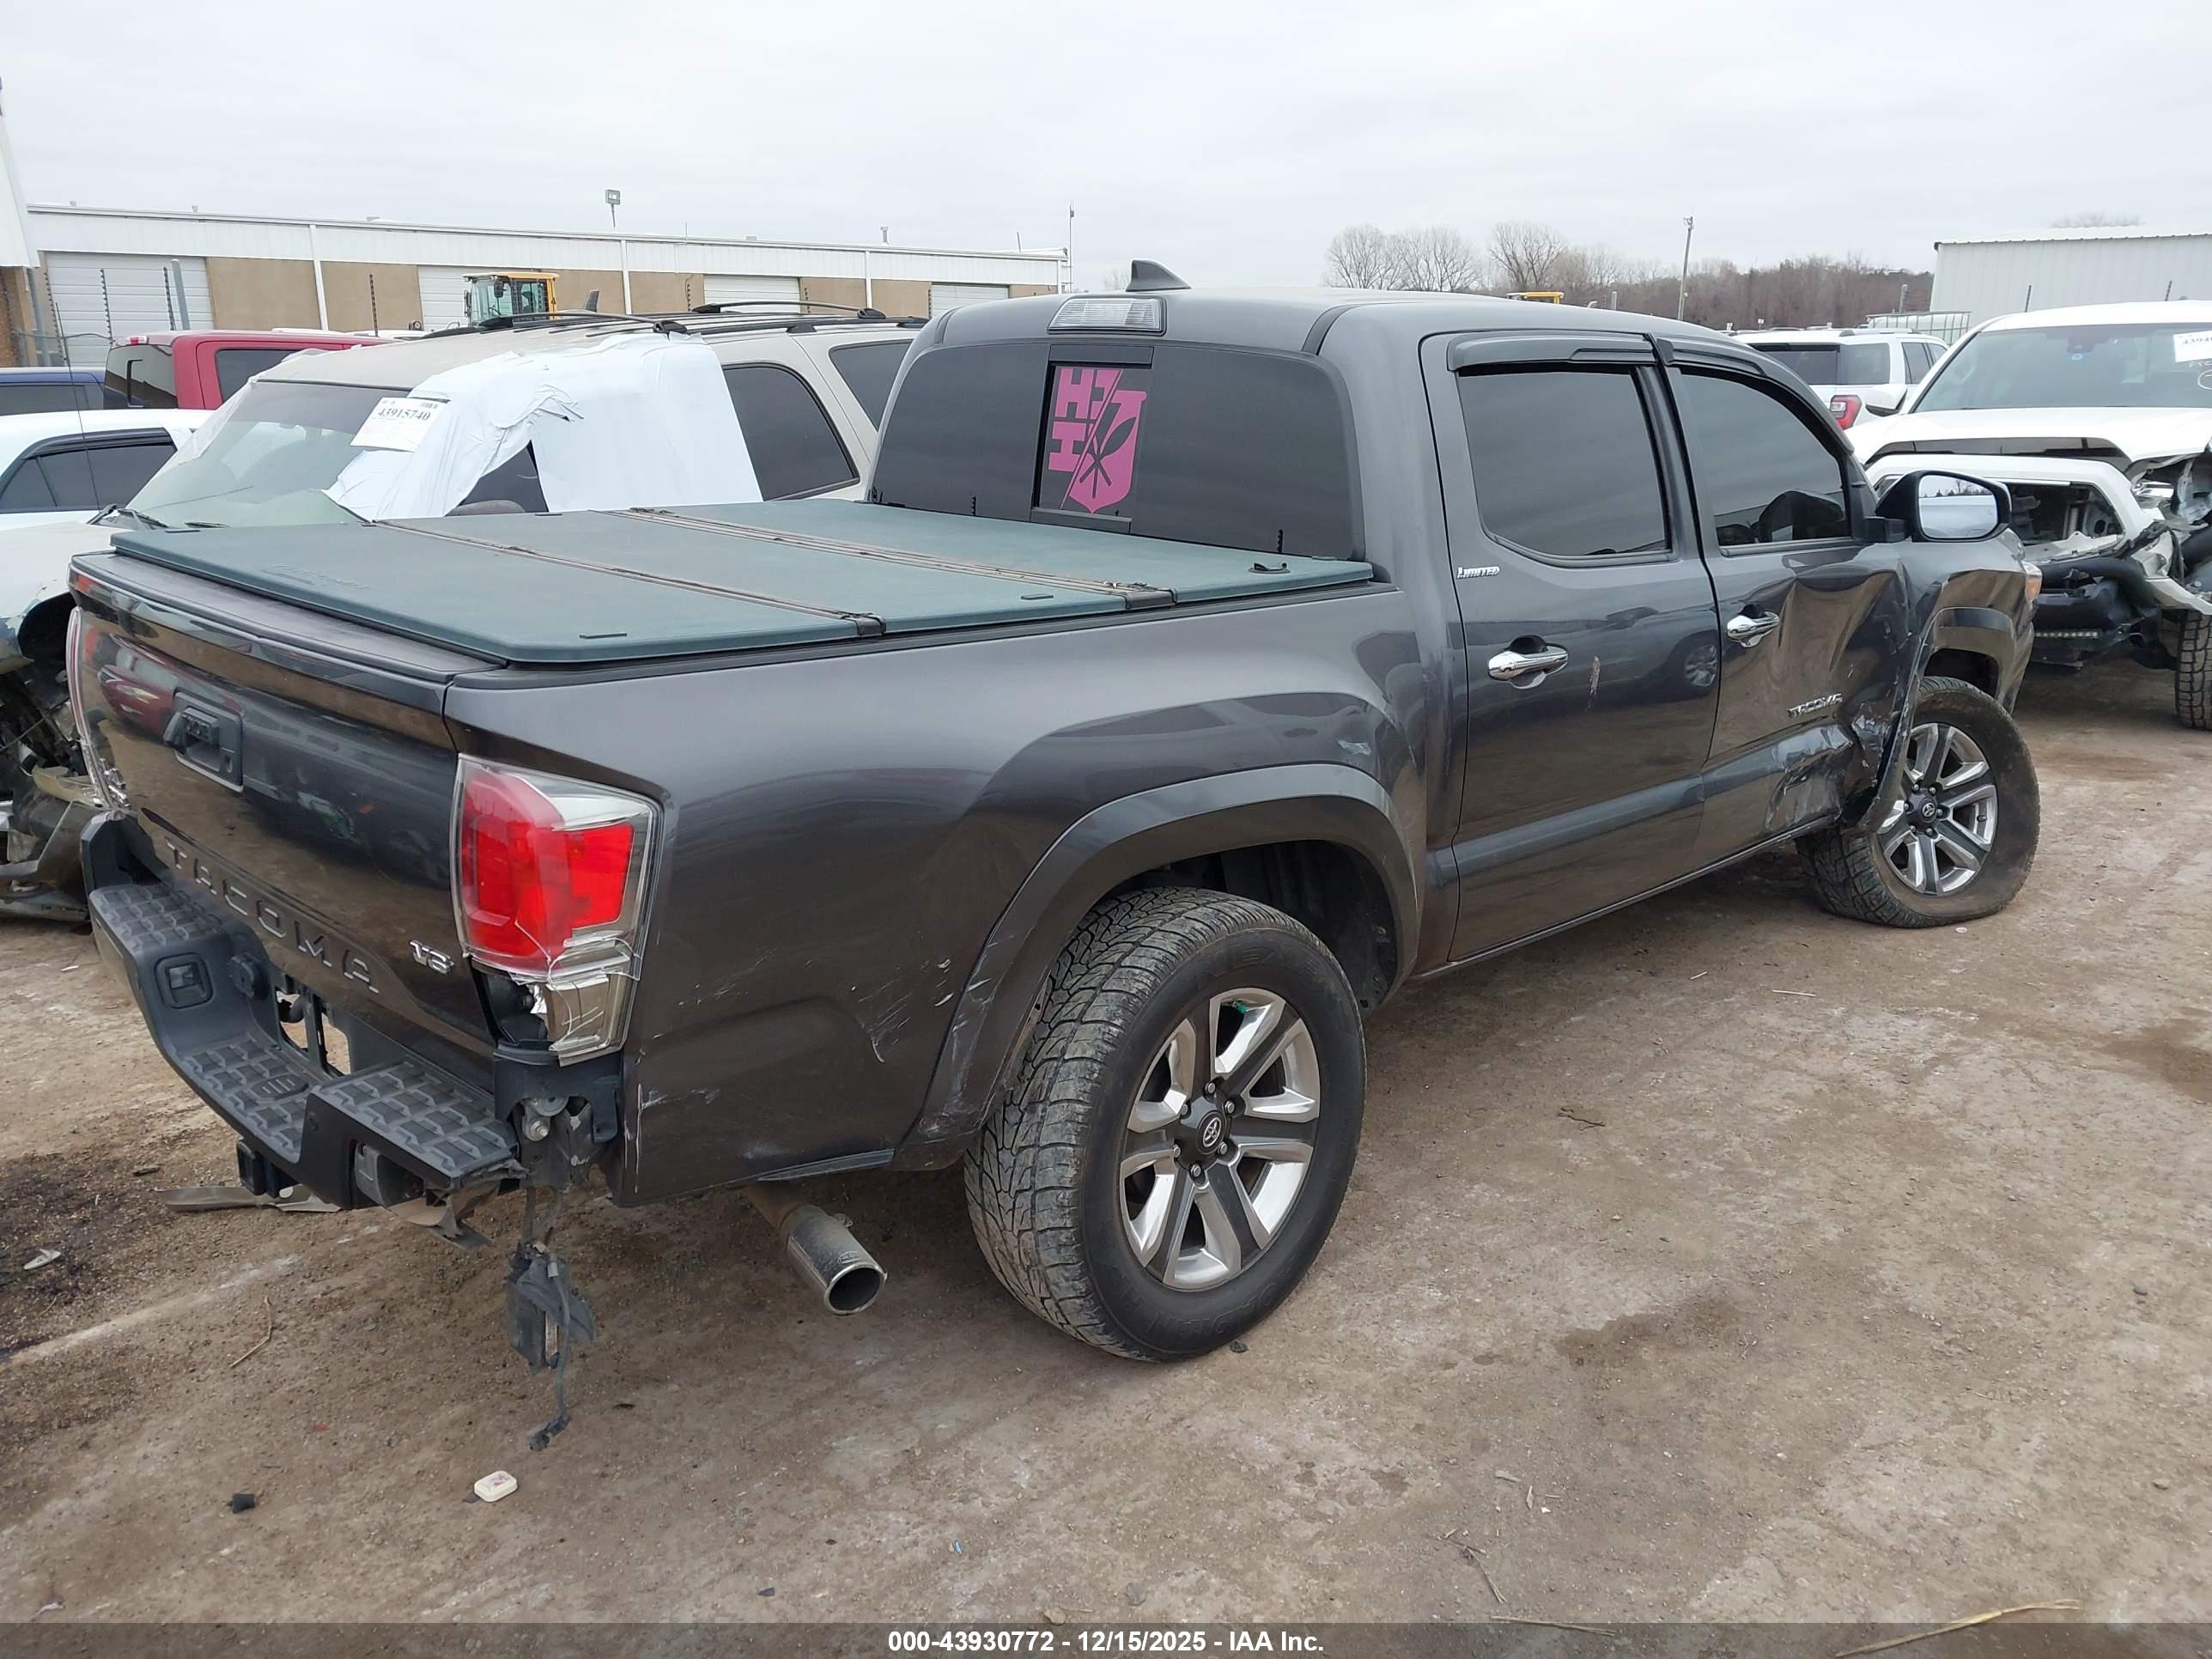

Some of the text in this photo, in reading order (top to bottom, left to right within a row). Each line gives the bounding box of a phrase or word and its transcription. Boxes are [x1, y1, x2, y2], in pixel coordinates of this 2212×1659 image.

[377, 408, 432, 421] 43915740
[164, 836, 380, 994] TACOMA
[409, 939, 455, 975] V6
